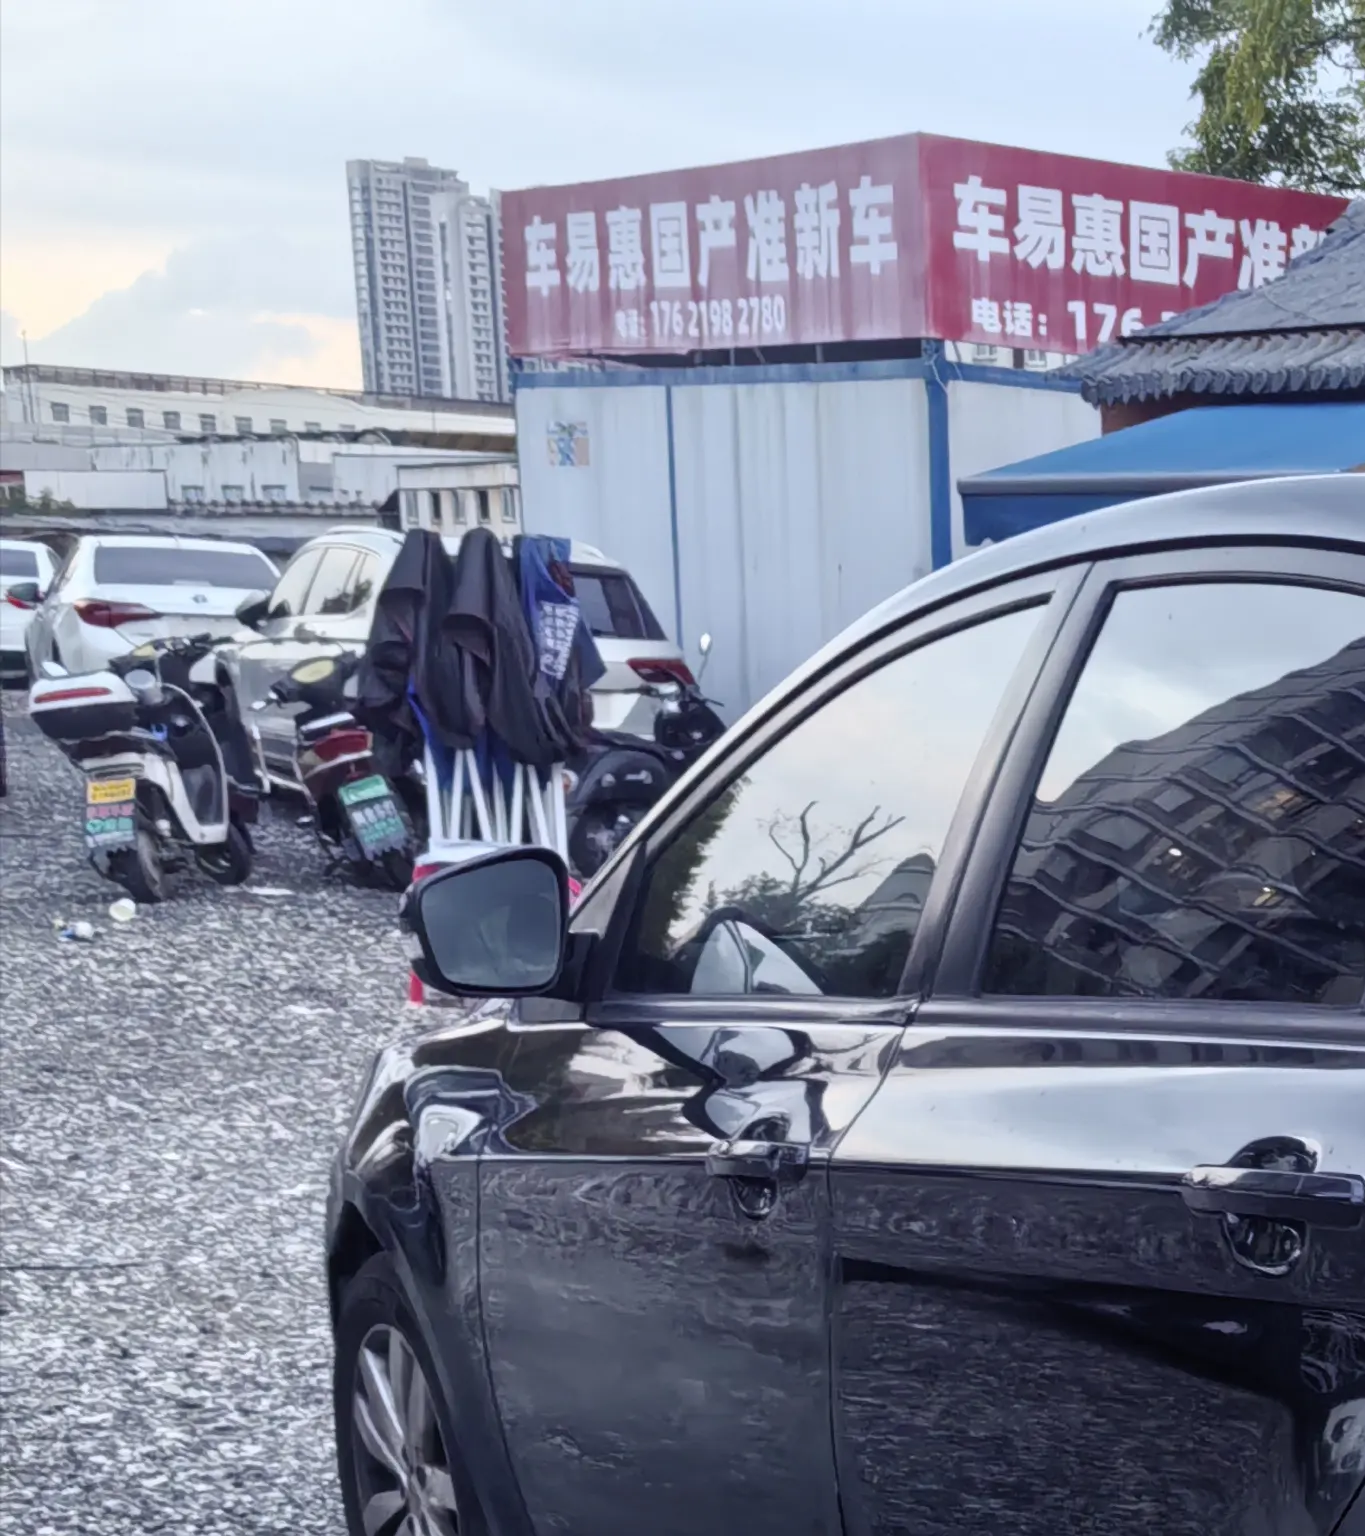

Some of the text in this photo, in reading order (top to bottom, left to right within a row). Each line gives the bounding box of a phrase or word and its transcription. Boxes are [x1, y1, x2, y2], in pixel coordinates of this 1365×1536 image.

[524, 175, 898, 297] 车易惠国产准新车
[649, 300, 684, 337] 176
[688, 300, 733, 336] 2198
[737, 295, 786, 336] 2780
